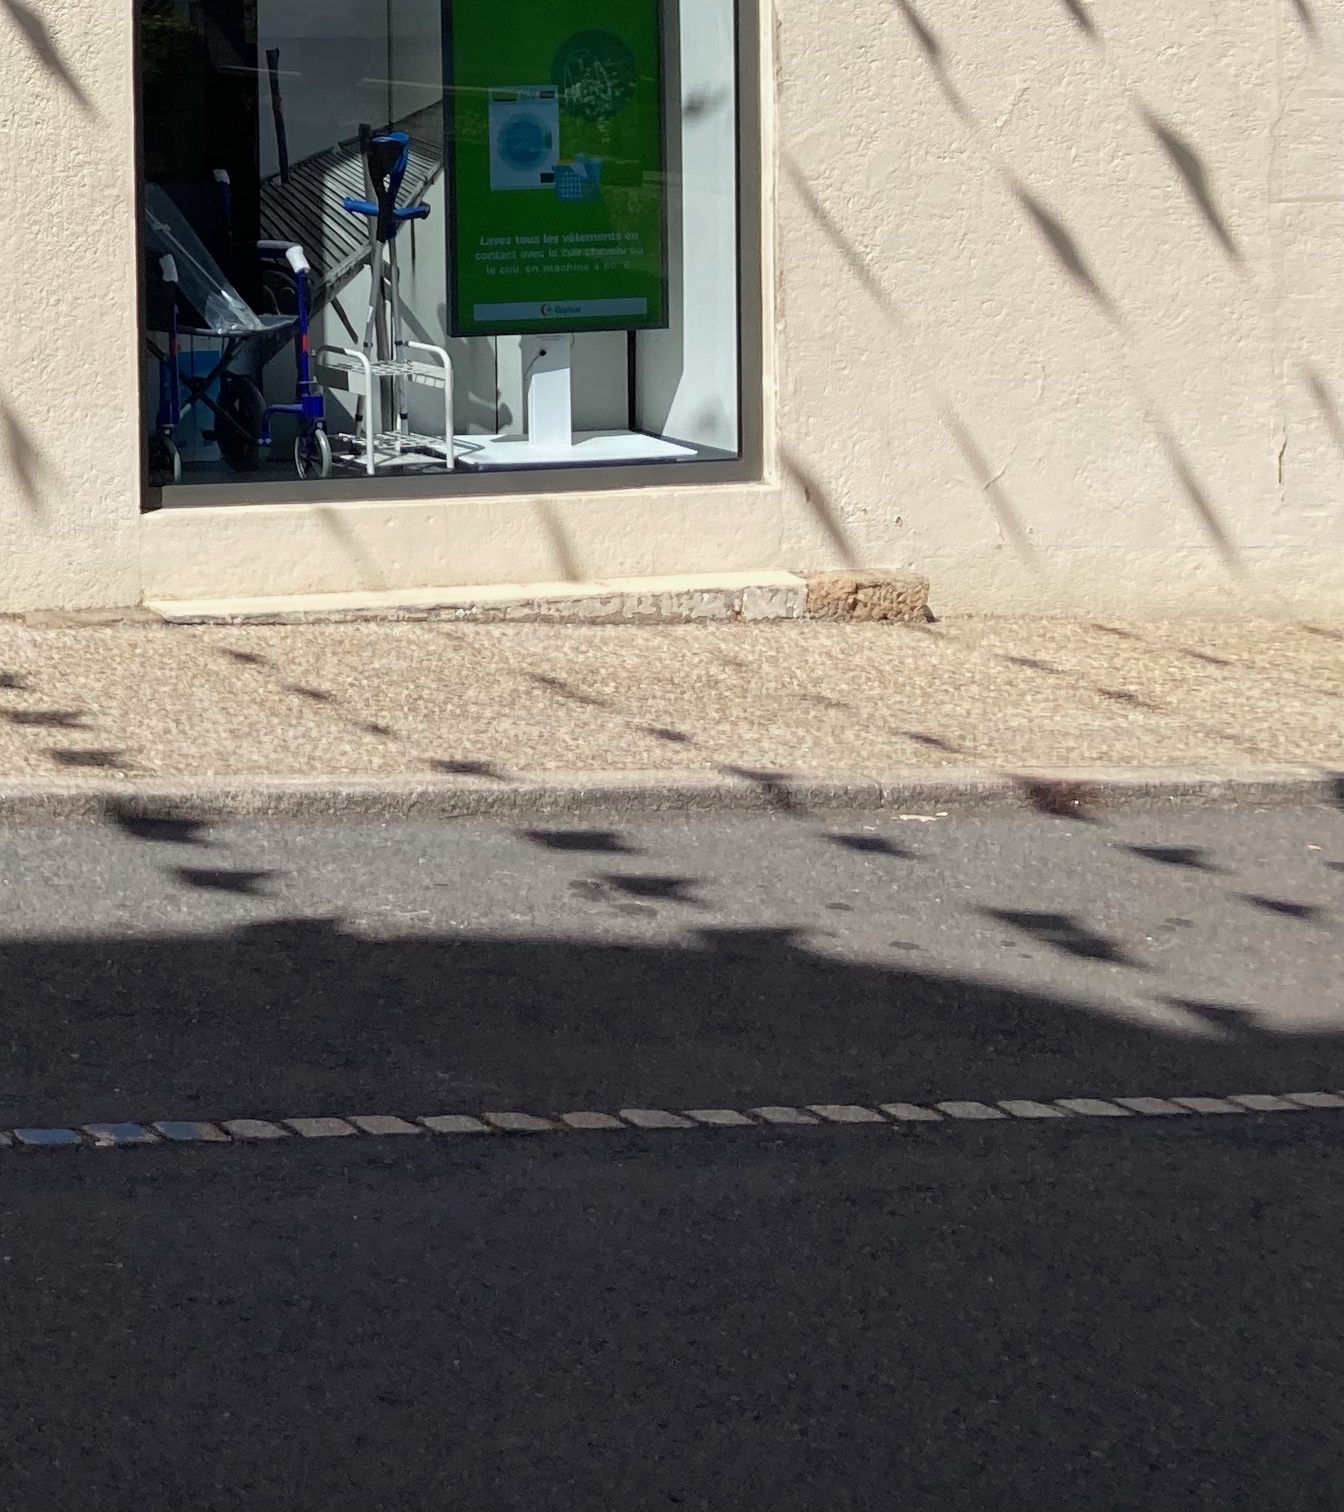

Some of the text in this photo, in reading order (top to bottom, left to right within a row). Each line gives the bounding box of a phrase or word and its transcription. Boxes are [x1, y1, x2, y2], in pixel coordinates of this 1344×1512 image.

[479, 231, 639, 246] Lavez tous les vêtements en
[475, 250, 517, 261] contact
[520, 250, 545, 259] avec
[548, 248, 558, 258] le
[561, 247, 582, 258] cuir
[585, 246, 626, 257] chevelu
[486, 265, 496, 275] le
[525, 265, 539, 274] en
[542, 262, 590, 274] machine
